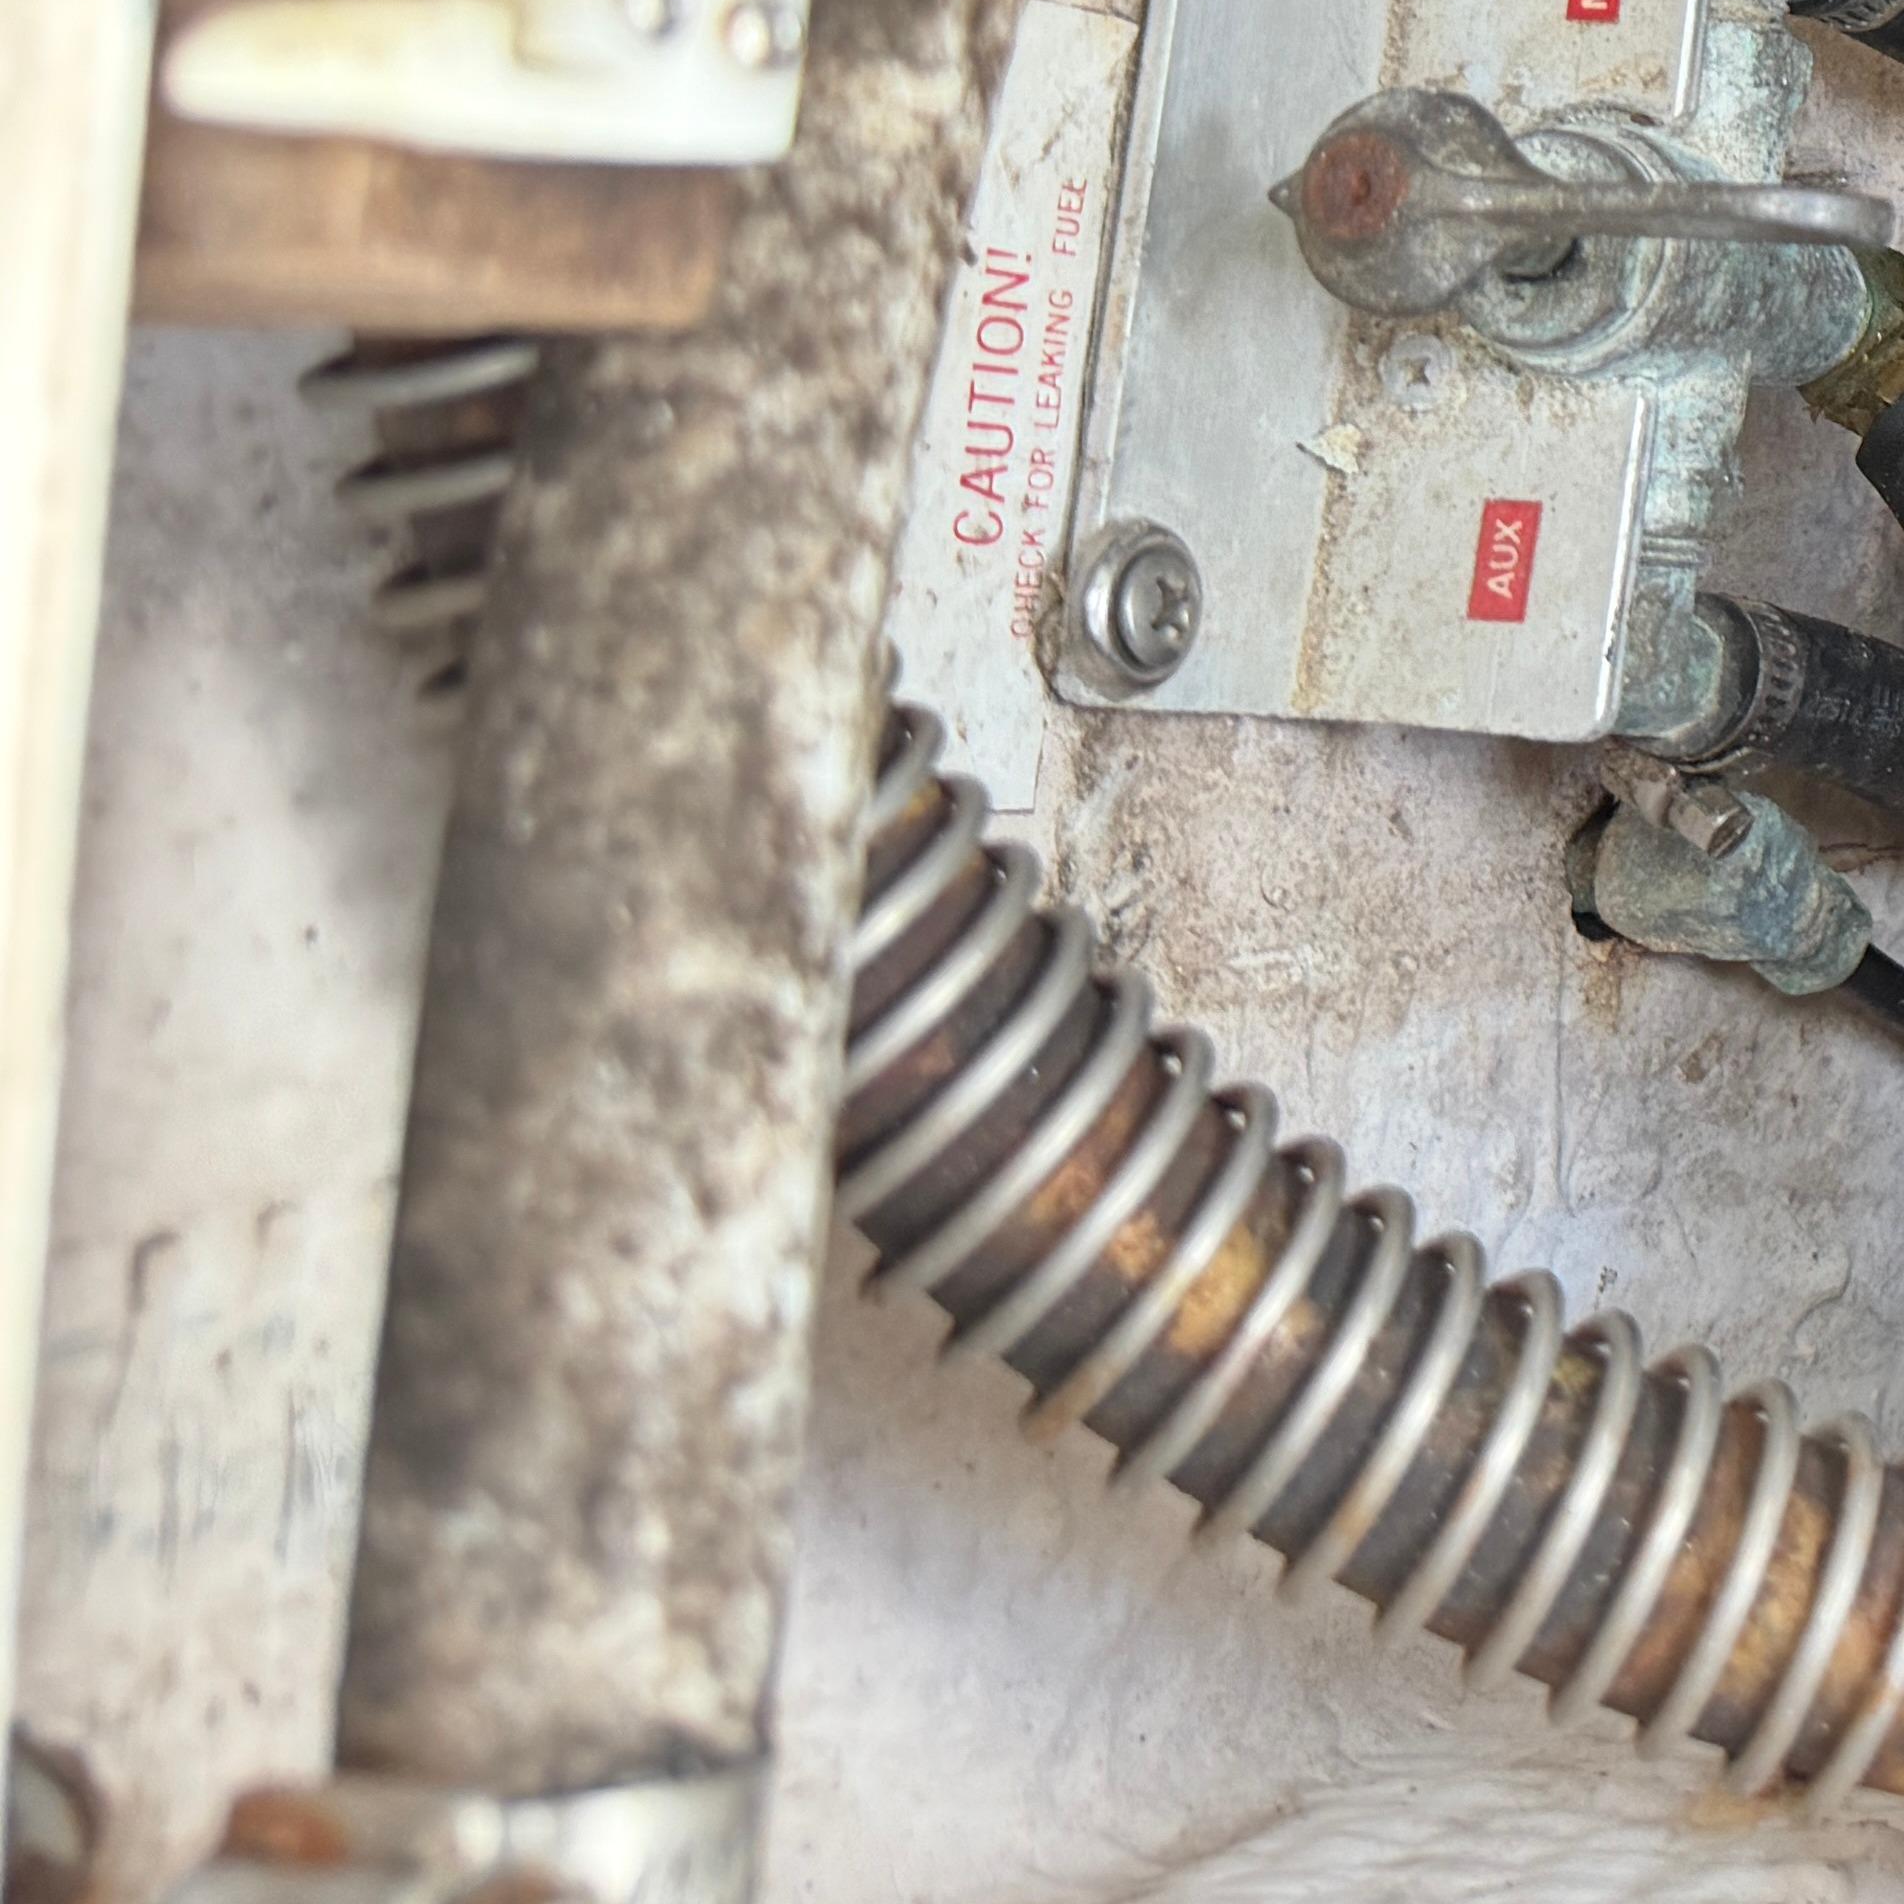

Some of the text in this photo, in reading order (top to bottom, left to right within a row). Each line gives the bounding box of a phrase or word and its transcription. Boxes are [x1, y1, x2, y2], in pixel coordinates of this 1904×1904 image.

[952, 248, 1033, 547] CAUTION!
[1009, 175, 1089, 640] CHECK FOR LEAKING FUEL
[1486, 516, 1524, 599] AUX
